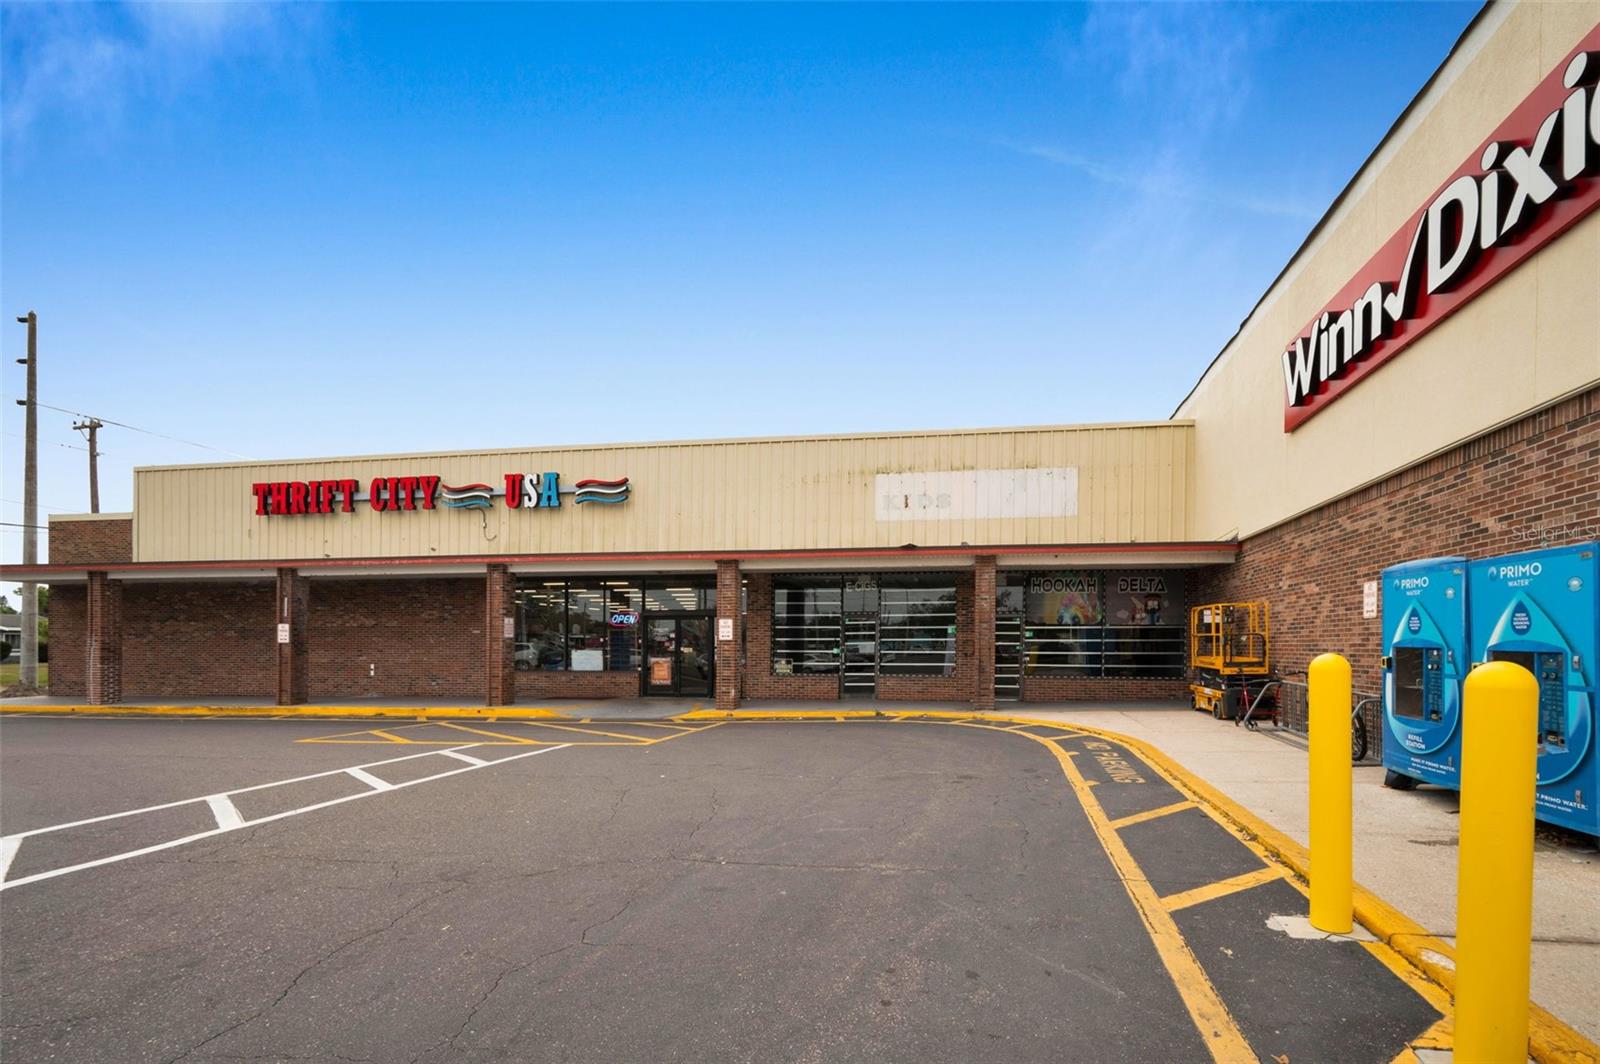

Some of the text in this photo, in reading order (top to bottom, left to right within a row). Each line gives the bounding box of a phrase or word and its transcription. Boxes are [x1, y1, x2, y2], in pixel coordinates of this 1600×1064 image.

[1282, 51, 1600, 407] Winn Dixi
[252, 472, 561, 516] THRIFT CITY USA
[1499, 562, 1542, 579] PRIMO
[1031, 577, 1098, 594] HOOKAH
[1118, 576, 1168, 593] DELTA
[1400, 576, 1429, 589] PRIMO
[611, 614, 636, 624] OPEN
[1405, 739, 1426, 750] STATION
[1407, 733, 1424, 743] REFILL
[1091, 751, 1147, 784] PARKING
[1540, 794, 1562, 804] PRIMO
